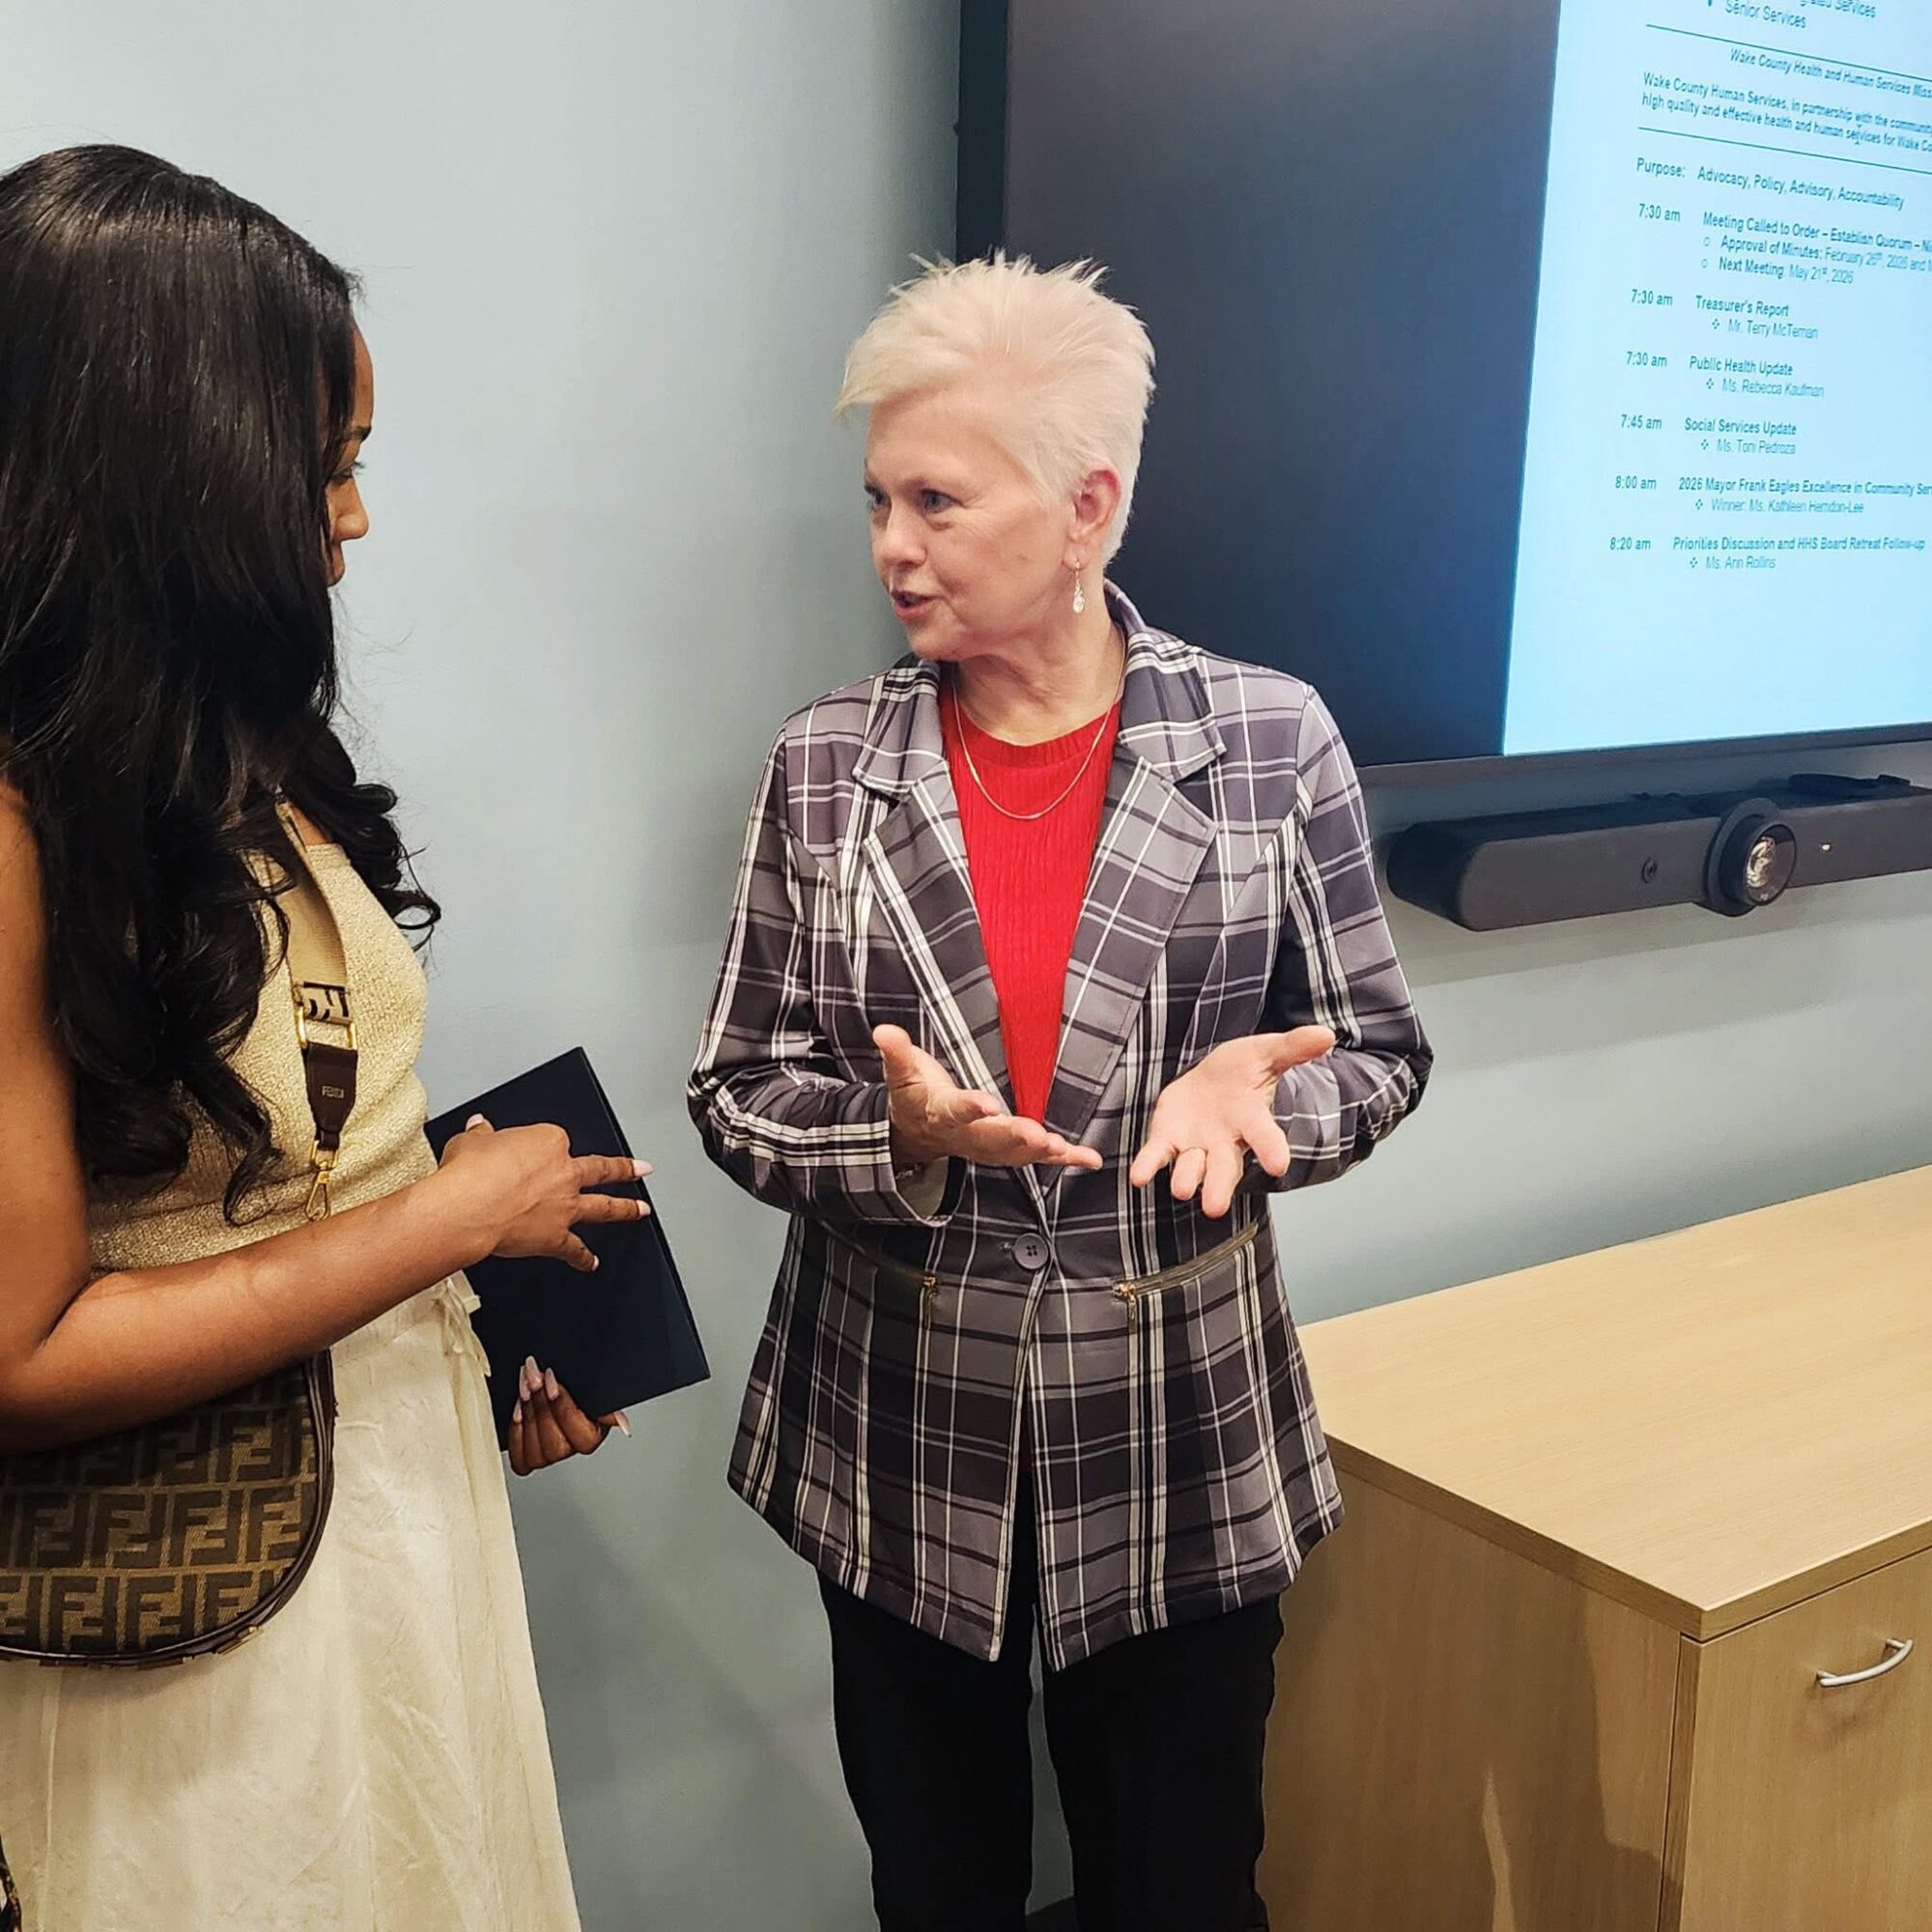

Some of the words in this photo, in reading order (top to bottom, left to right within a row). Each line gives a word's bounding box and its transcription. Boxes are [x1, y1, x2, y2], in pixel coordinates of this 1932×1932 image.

[1725, 0, 1759, 17] Senior
[1762, 5, 1806, 28] Services
[1730, 47, 1756, 65] Wake
[1758, 54, 1792, 74] County
[1794, 60, 1823, 76] Health
[1824, 69, 1842, 81] and
[1842, 71, 1874, 86] Human
[1876, 76, 1911, 94] Services
[1643, 71, 1670, 89] Wake
[1673, 77, 1708, 99] County
[1711, 83, 1745, 101] Human
[1802, 103, 1854, 123] partnership
[1874, 115, 1889, 127] the
[1642, 93, 1664, 110] high
[1666, 99, 1700, 117] quality
[1701, 104, 1720, 117] and
[1722, 106, 1763, 125] effective
[1764, 113, 1793, 128] health
[1795, 120, 1812, 132] and
[1813, 122, 1844, 137] human
[1884, 132, 1896, 146] for
[1636, 157, 1686, 178] Purpose:
[1697, 166, 1751, 190] Advocacy,
[1753, 174, 1788, 195] Policy,
[1789, 180, 1835, 201] Advisory,
[1837, 186, 1905, 211] Accountability
[1638, 203, 1662, 219] 7:30
[1663, 209, 1681, 222] am
[1703, 212, 1745, 233] Meeting
[1747, 217, 1778, 234] Called
[1780, 221, 1790, 235] to
[1792, 223, 1821, 239] Order
[1831, 227, 1874, 245] Establish
[1875, 234, 1913, 250] Quorum
[1720, 235, 1767, 253] Approval
[1769, 242, 1780, 255] of
[1781, 242, 1824, 261] Minutes:
[1825, 246, 1863, 267] February
[1910, 260, 1926, 271] and
[1719, 256, 1743, 272] Next
[1789, 264, 1808, 282] May
[1831, 269, 1854, 284] 2026
[1631, 288, 1654, 305] 7:30
[1656, 294, 1673, 307] am
[1755, 300, 1790, 318] Report
[1728, 318, 1743, 333] Mr.
[1747, 320, 1771, 338] Terry
[1627, 351, 1649, 366] 7:30
[1651, 355, 1667, 367] am
[1690, 355, 1722, 372] Public
[1724, 358, 1756, 374] Health
[1759, 361, 1793, 377] Update
[1722, 378, 1739, 393] Ms.
[1742, 380, 1782, 395] Rebecca
[1621, 413, 1643, 429] 7:45
[1645, 418, 1662, 430] am
[1685, 417, 1716, 432] Social
[1719, 418, 1760, 434] Services
[1763, 421, 1797, 437] Update
[1717, 439, 1733, 453] Ms.
[1737, 440, 1756, 453] Toni
[1758, 440, 1796, 455] Pedroza
[1615, 475, 1638, 490] 8:00
[1641, 478, 1657, 490] am
[1678, 477, 1703, 491] 2026
[1705, 477, 1736, 494] Mayor
[1739, 478, 1766, 492] Frank
[1769, 478, 1800, 495] Eagles
[1802, 480, 1852, 494] Excellence
[1854, 481, 1863, 494] in
[1864, 481, 1915, 497] Community
[1749, 498, 1765, 512] Ms.
[1768, 499, 1808, 513] Kathleen
[1609, 537, 1633, 551] 8:20
[1634, 539, 1651, 551] am
[1672, 536, 1719, 551] Priorities
[1721, 537, 1776, 550] Discussion
[1777, 538, 1796, 550] and
[1797, 537, 1818, 550] HHS
[1820, 537, 1848, 550] Board
[1849, 537, 1882, 550] Retreat
[1883, 537, 1925, 553] Follow-up
[1706, 556, 1722, 569] Ms.
[1724, 556, 1744, 569] Ann
